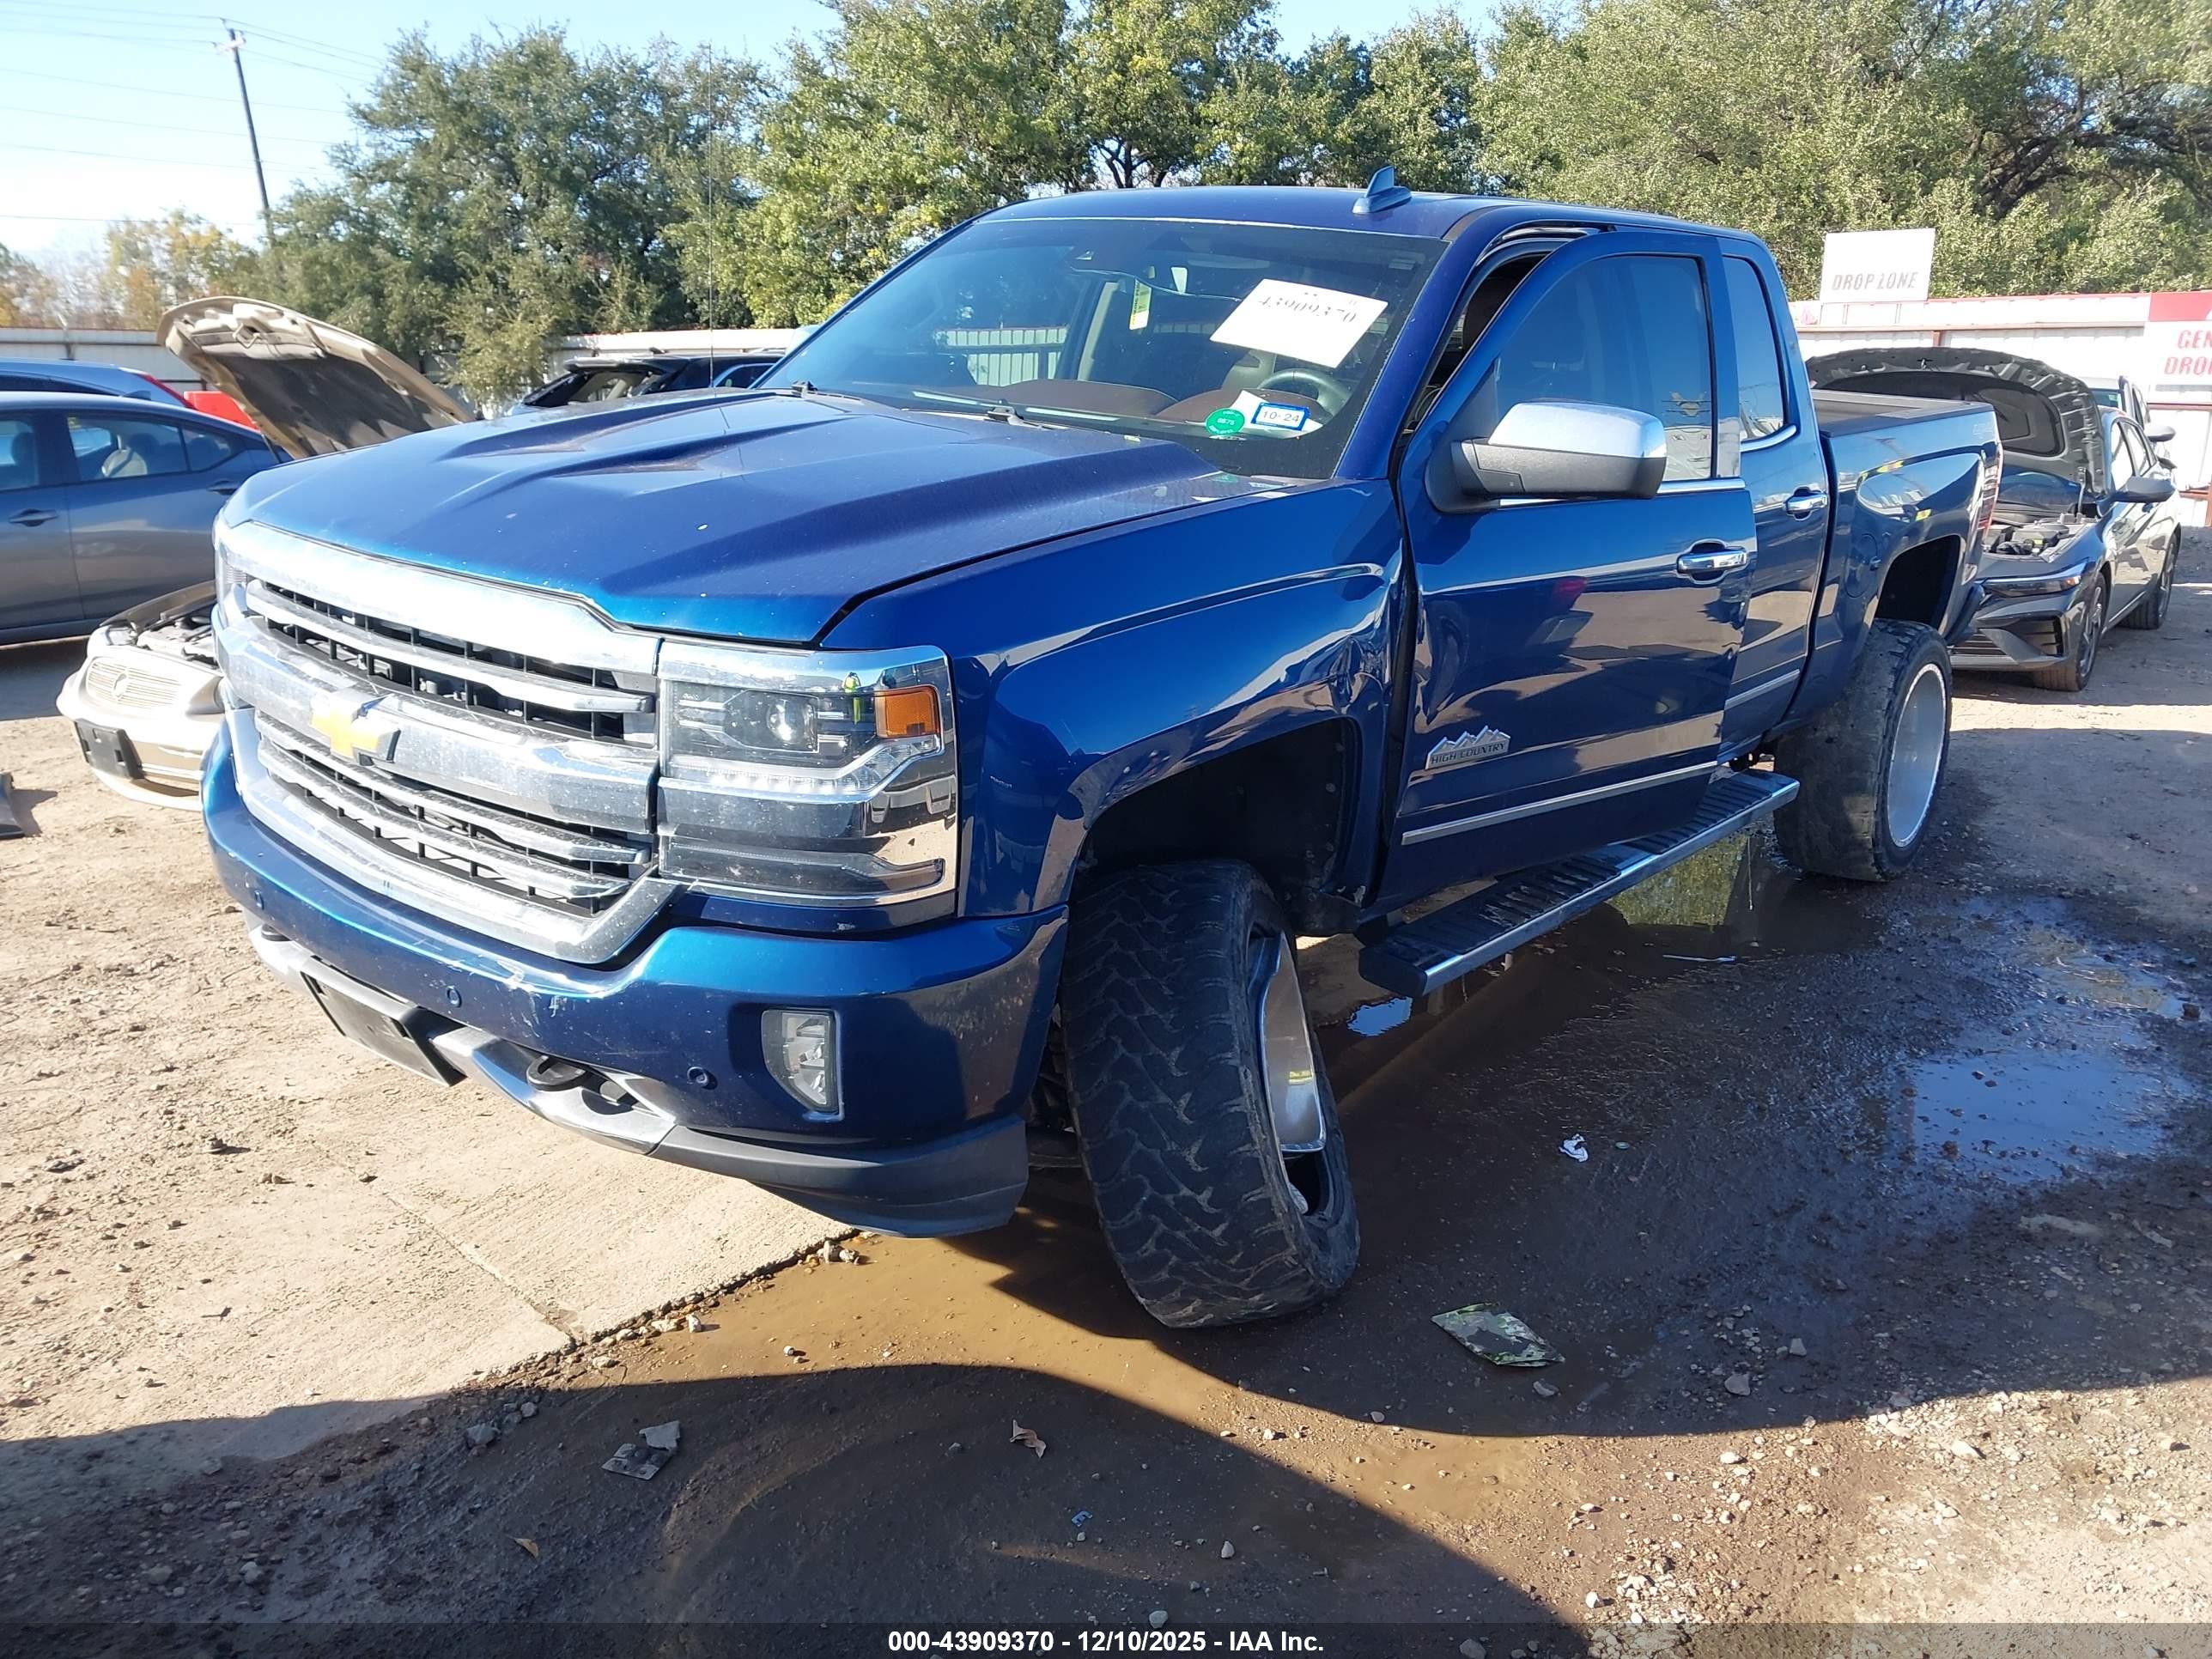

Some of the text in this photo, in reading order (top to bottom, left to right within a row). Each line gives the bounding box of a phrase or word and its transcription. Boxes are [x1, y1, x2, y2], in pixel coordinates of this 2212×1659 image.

[1832, 271, 1918, 290] DROP ZONE
[1431, 742, 1505, 765] HIGH COUNTRY
